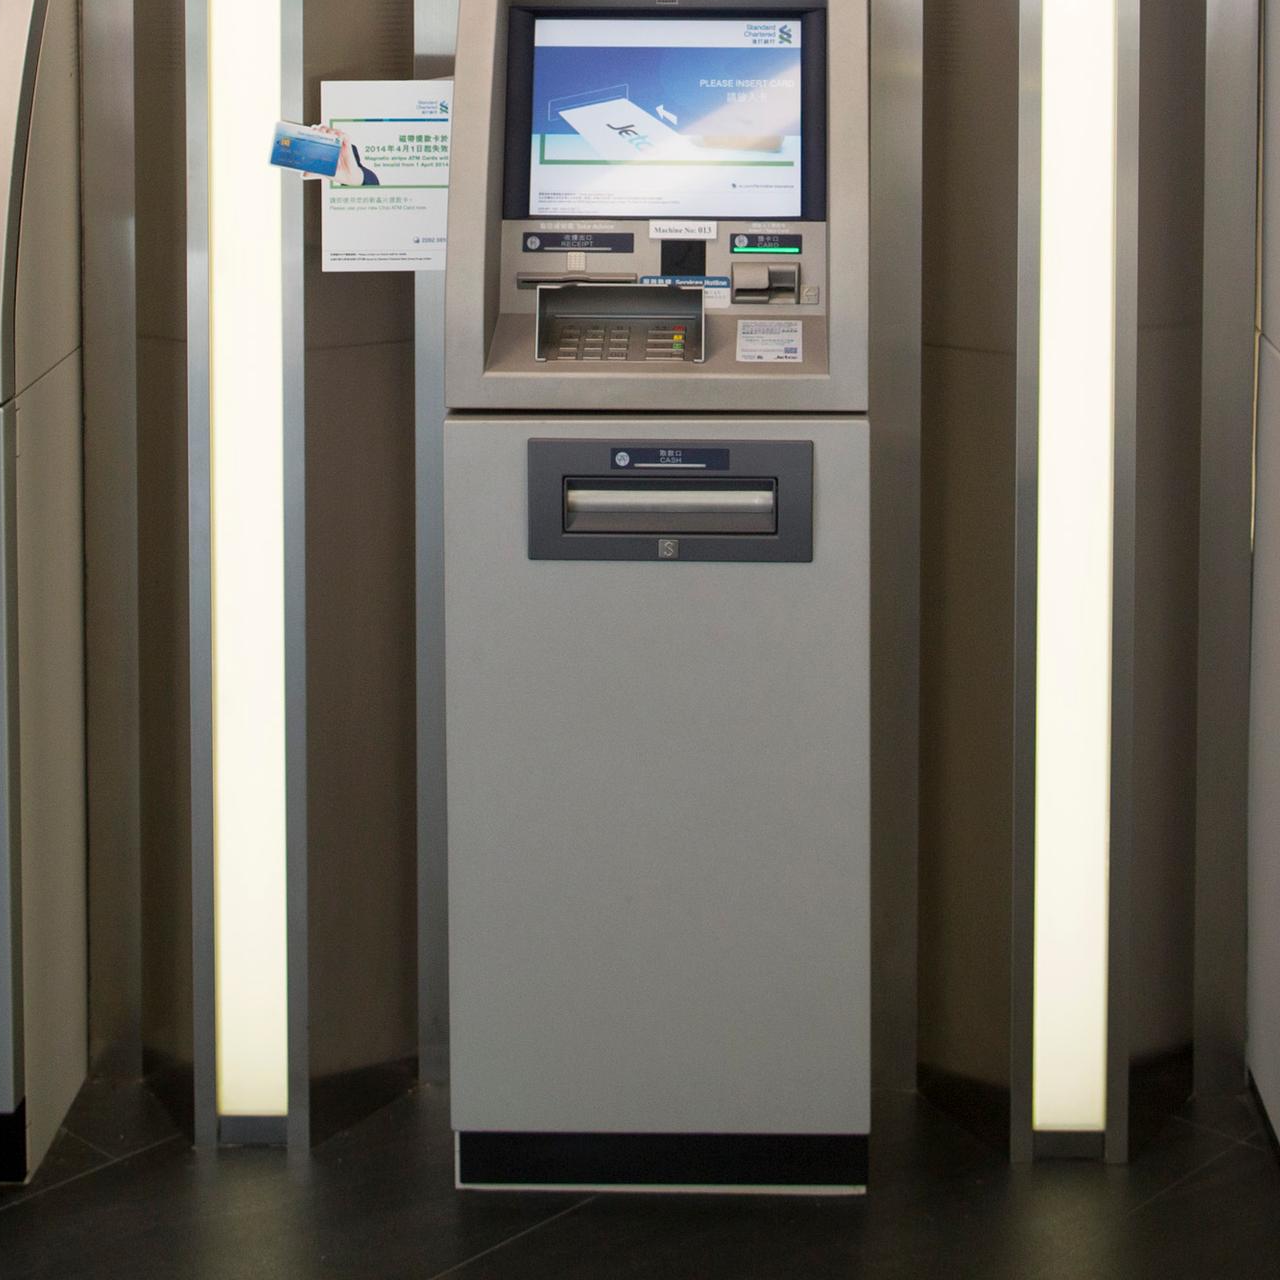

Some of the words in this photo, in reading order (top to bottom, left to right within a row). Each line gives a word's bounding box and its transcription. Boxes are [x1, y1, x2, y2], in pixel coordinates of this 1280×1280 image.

[699, 79, 734, 88] PLEASE
[653, 226, 681, 234] Machine
[697, 226, 713, 234] 013
